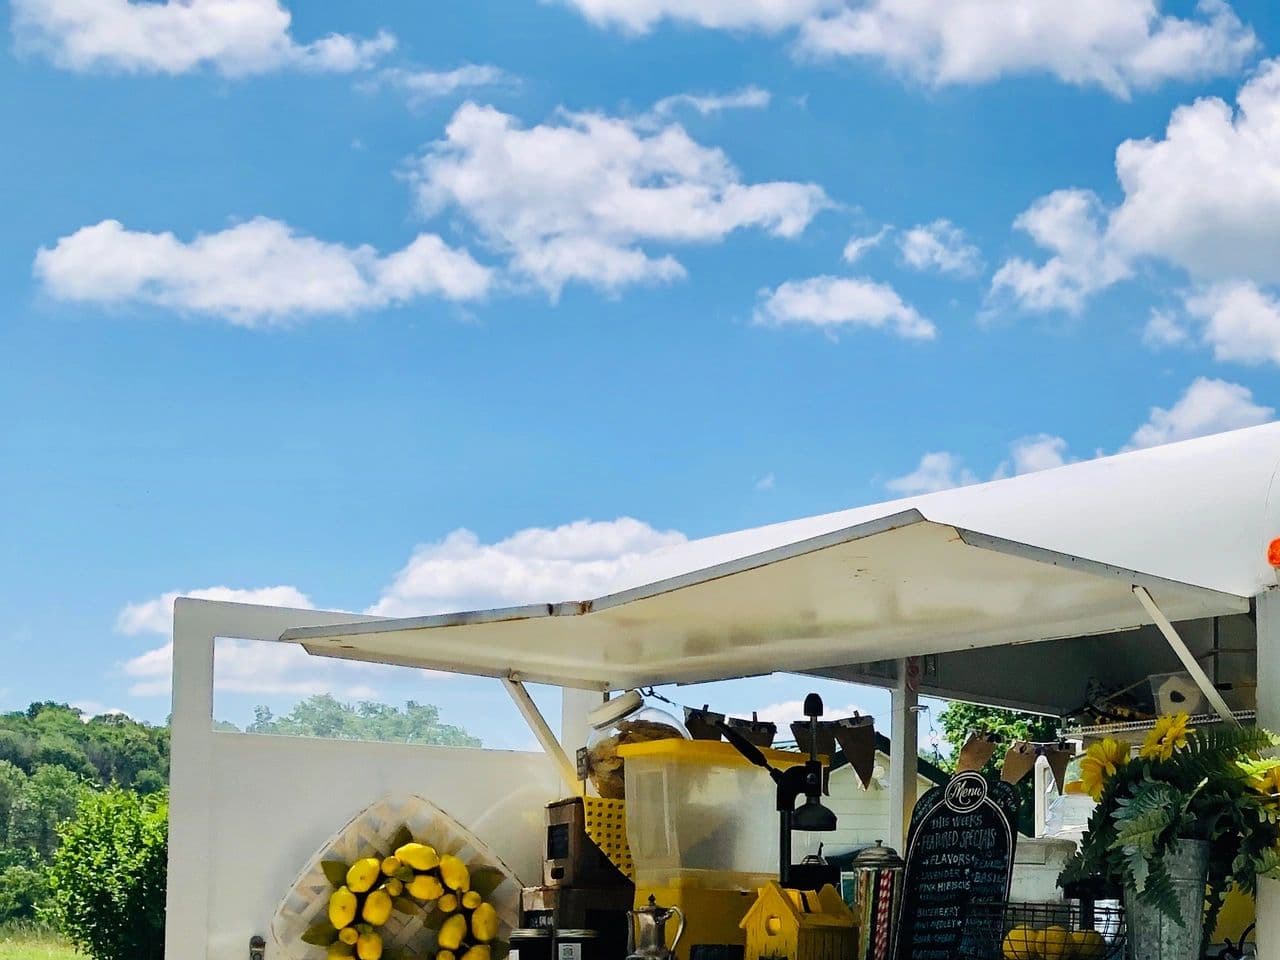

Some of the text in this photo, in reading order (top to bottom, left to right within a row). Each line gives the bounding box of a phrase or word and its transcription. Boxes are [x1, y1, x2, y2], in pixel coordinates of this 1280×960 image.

[949, 780, 982, 804] Menu
[922, 830, 958, 850] FEATURED
[930, 853, 971, 866] FLAVORS
[937, 881, 971, 892] HIBISCUS
